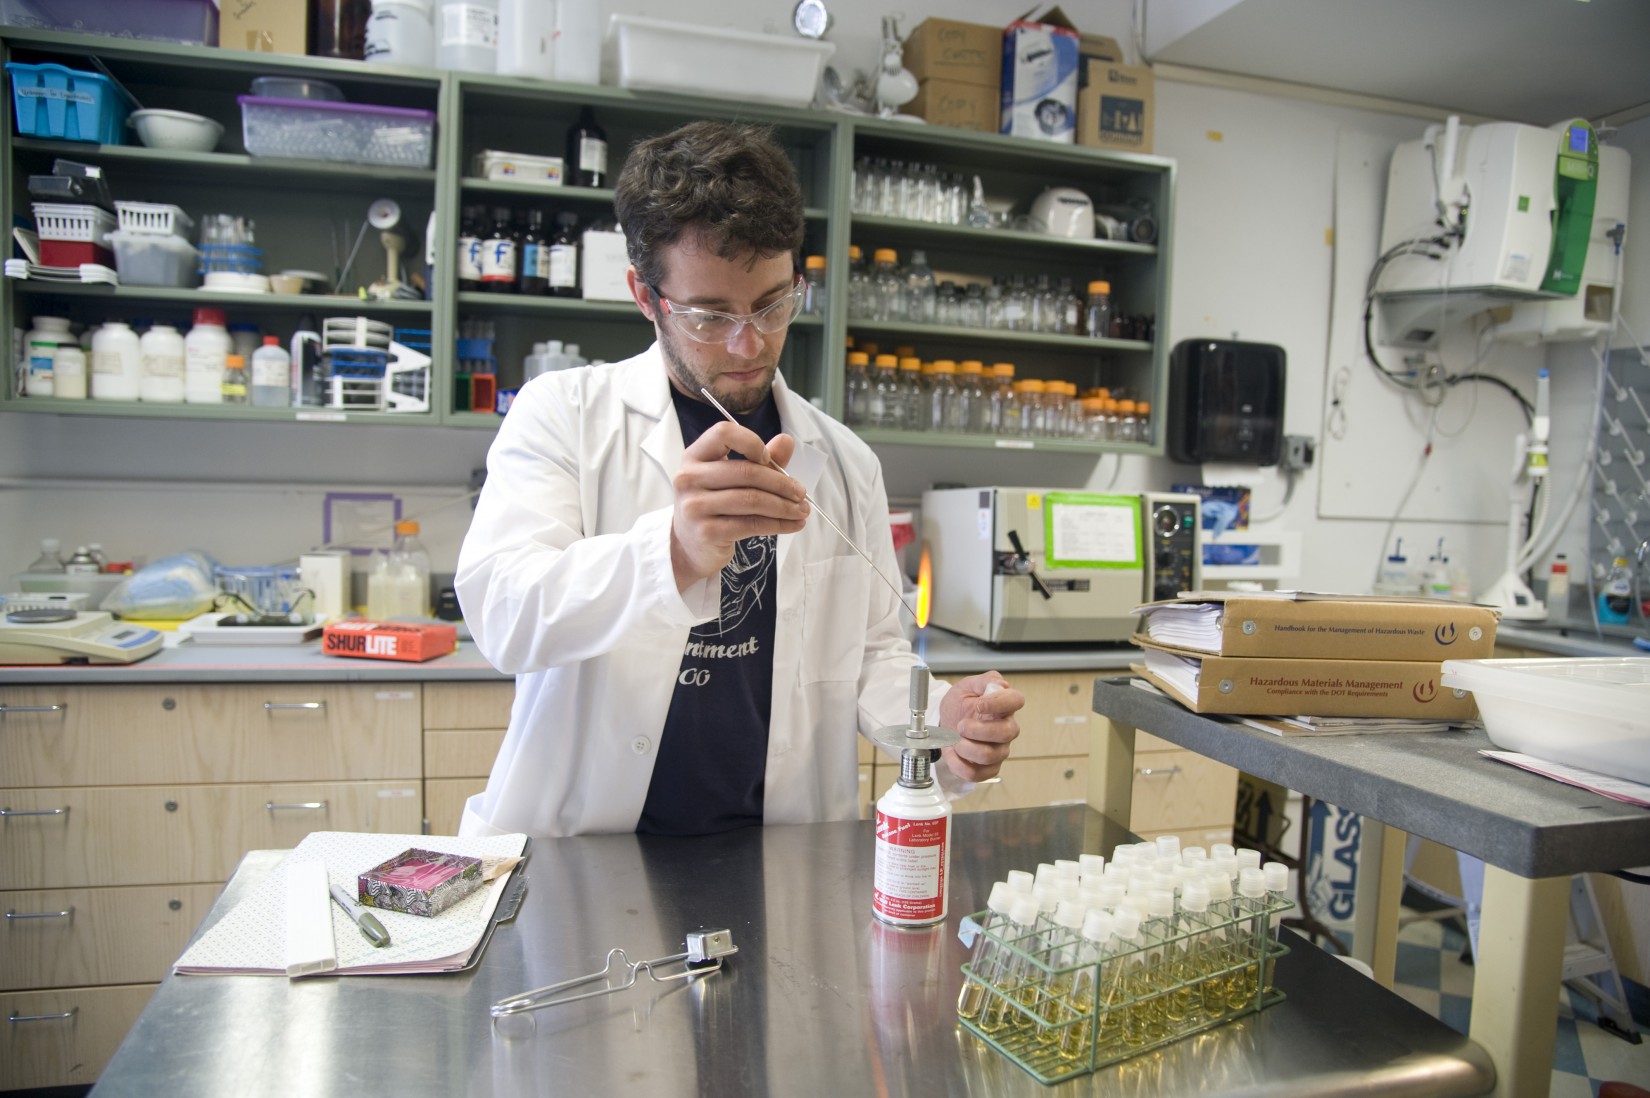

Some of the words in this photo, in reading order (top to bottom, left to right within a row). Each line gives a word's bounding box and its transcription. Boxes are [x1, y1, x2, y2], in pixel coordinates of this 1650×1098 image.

[1274, 624, 1306, 632] Handbook
[1318, 625, 1327, 633] the
[1329, 626, 1366, 634] Management
[1375, 627, 1406, 635] Hazardous
[327, 634, 397, 655] SHURLITE
[1250, 677, 1298, 687] Hazardous
[1301, 678, 1343, 688] Materials
[1345, 679, 1403, 691] Management
[1267, 687, 1302, 696] Compliance
[1304, 688, 1318, 696] with
[1348, 690, 1388, 698] Requirements
[1329, 805, 1361, 921] GLAS
